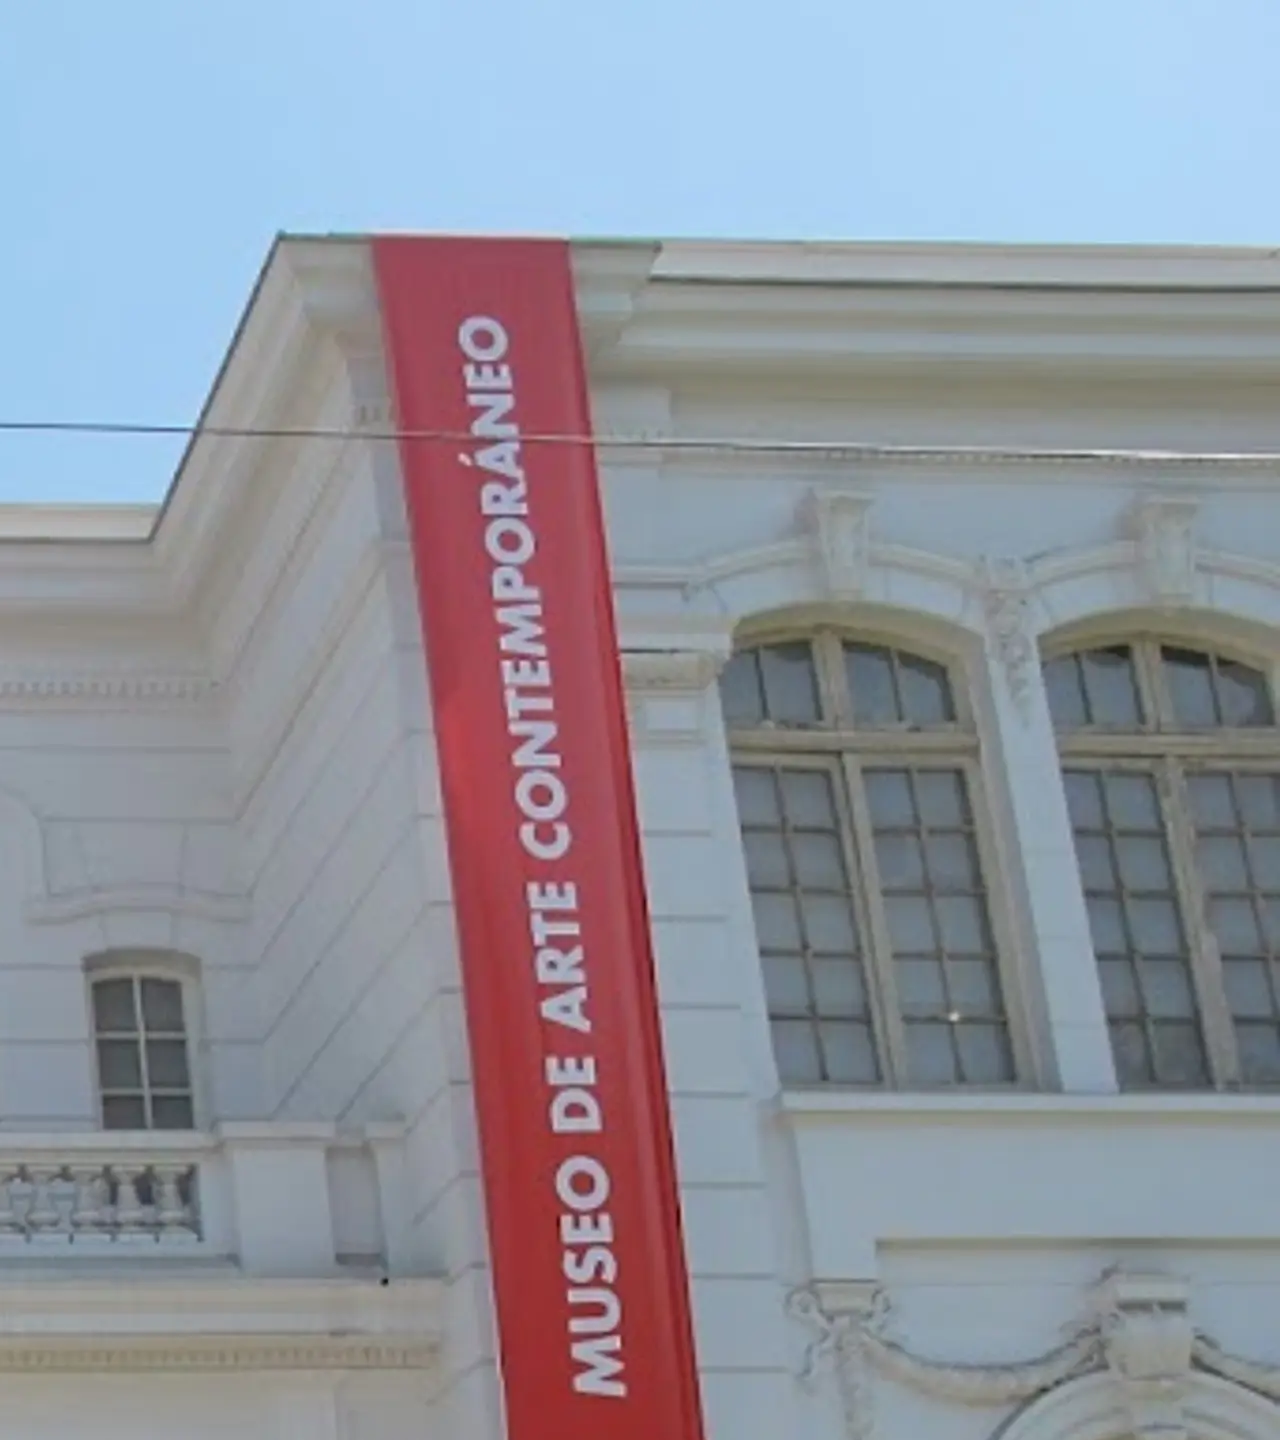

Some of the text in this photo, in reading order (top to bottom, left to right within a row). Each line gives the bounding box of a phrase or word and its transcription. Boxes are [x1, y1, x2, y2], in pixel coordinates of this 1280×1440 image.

[458, 315, 628, 1398] MUSEO DE ARTE CONTEMPORÁNEO
